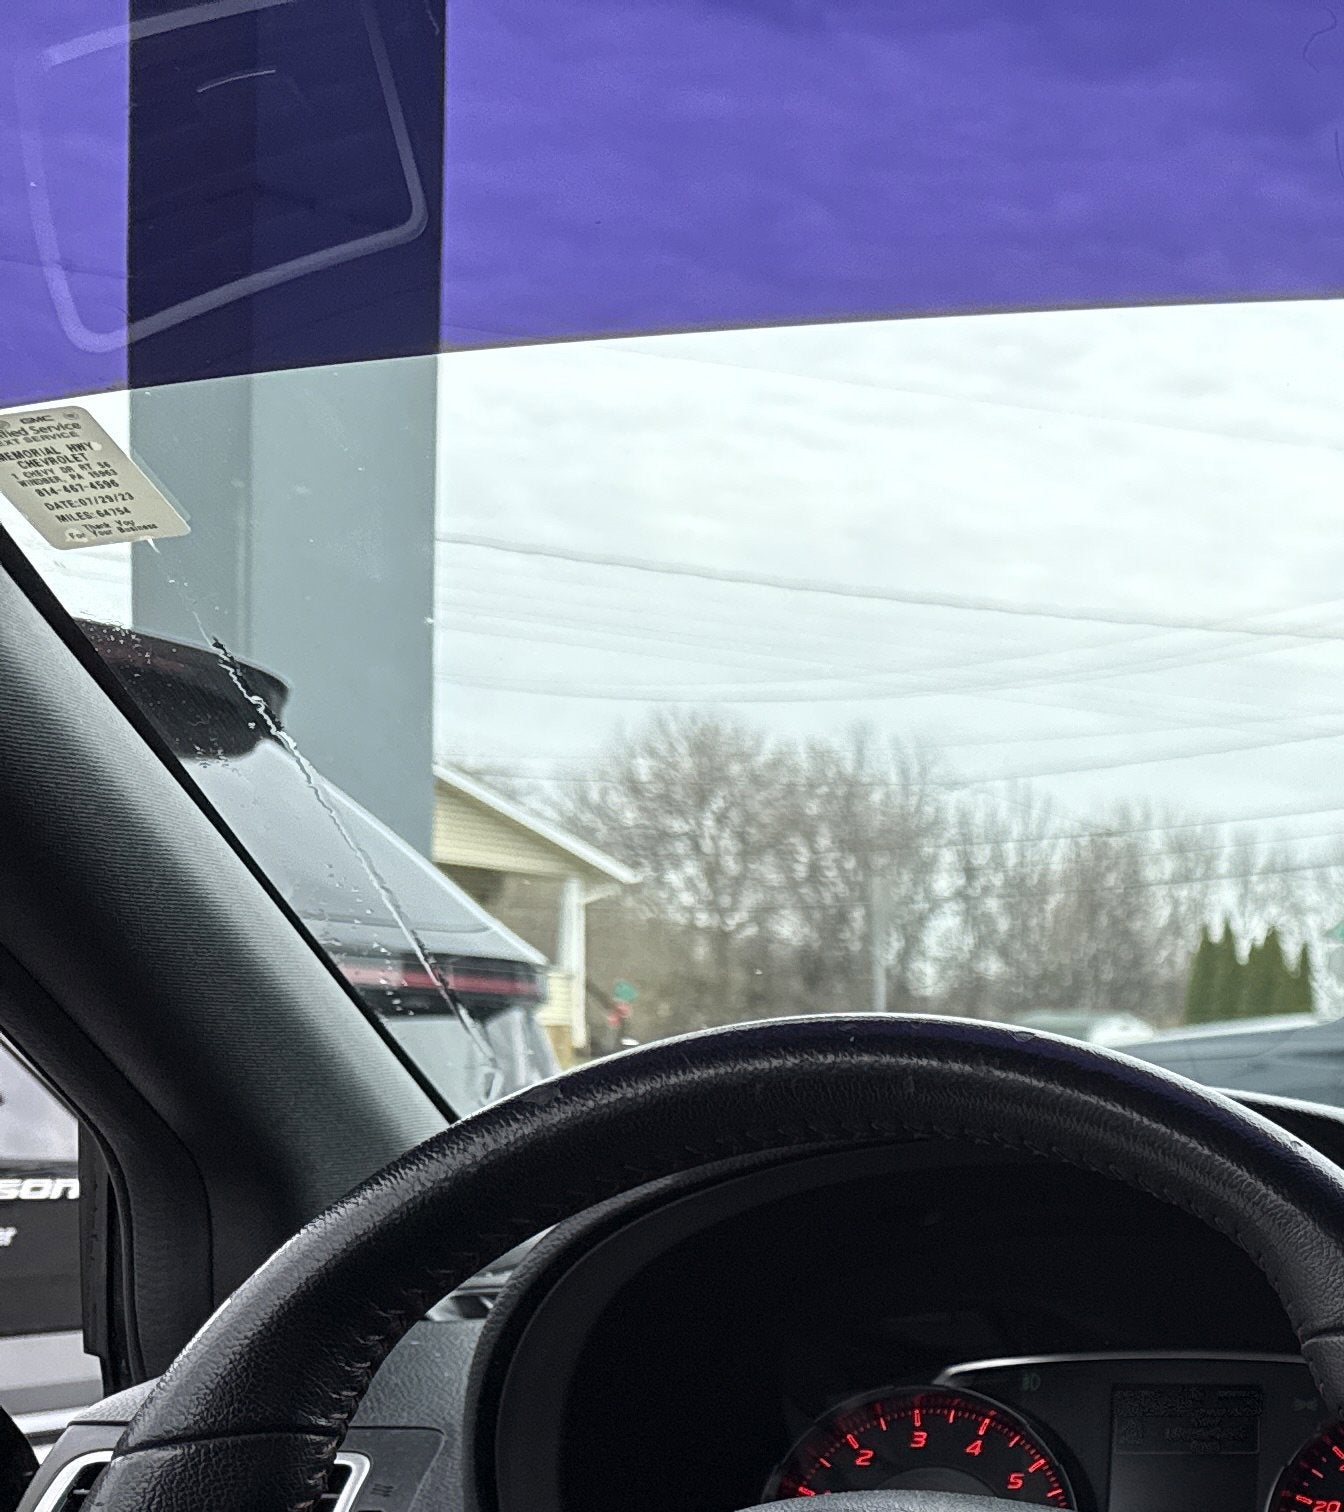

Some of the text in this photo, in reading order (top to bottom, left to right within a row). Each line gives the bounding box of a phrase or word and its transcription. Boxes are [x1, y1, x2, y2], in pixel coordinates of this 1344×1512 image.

[20, 415, 54, 424] GMC
[29, 422, 82, 434] Service
[23, 431, 80, 443] SERVICE
[65, 441, 94, 452] HWY
[17, 452, 89, 469] CHEVROLET
[22, 467, 55, 478] CHEVY
[35, 479, 119, 497] 814-467-4596
[910, 1430, 928, 1449] 3
[964, 1438, 984, 1456] 4
[855, 1449, 874, 1466] 2
[1007, 1471, 1025, 1490] 5
